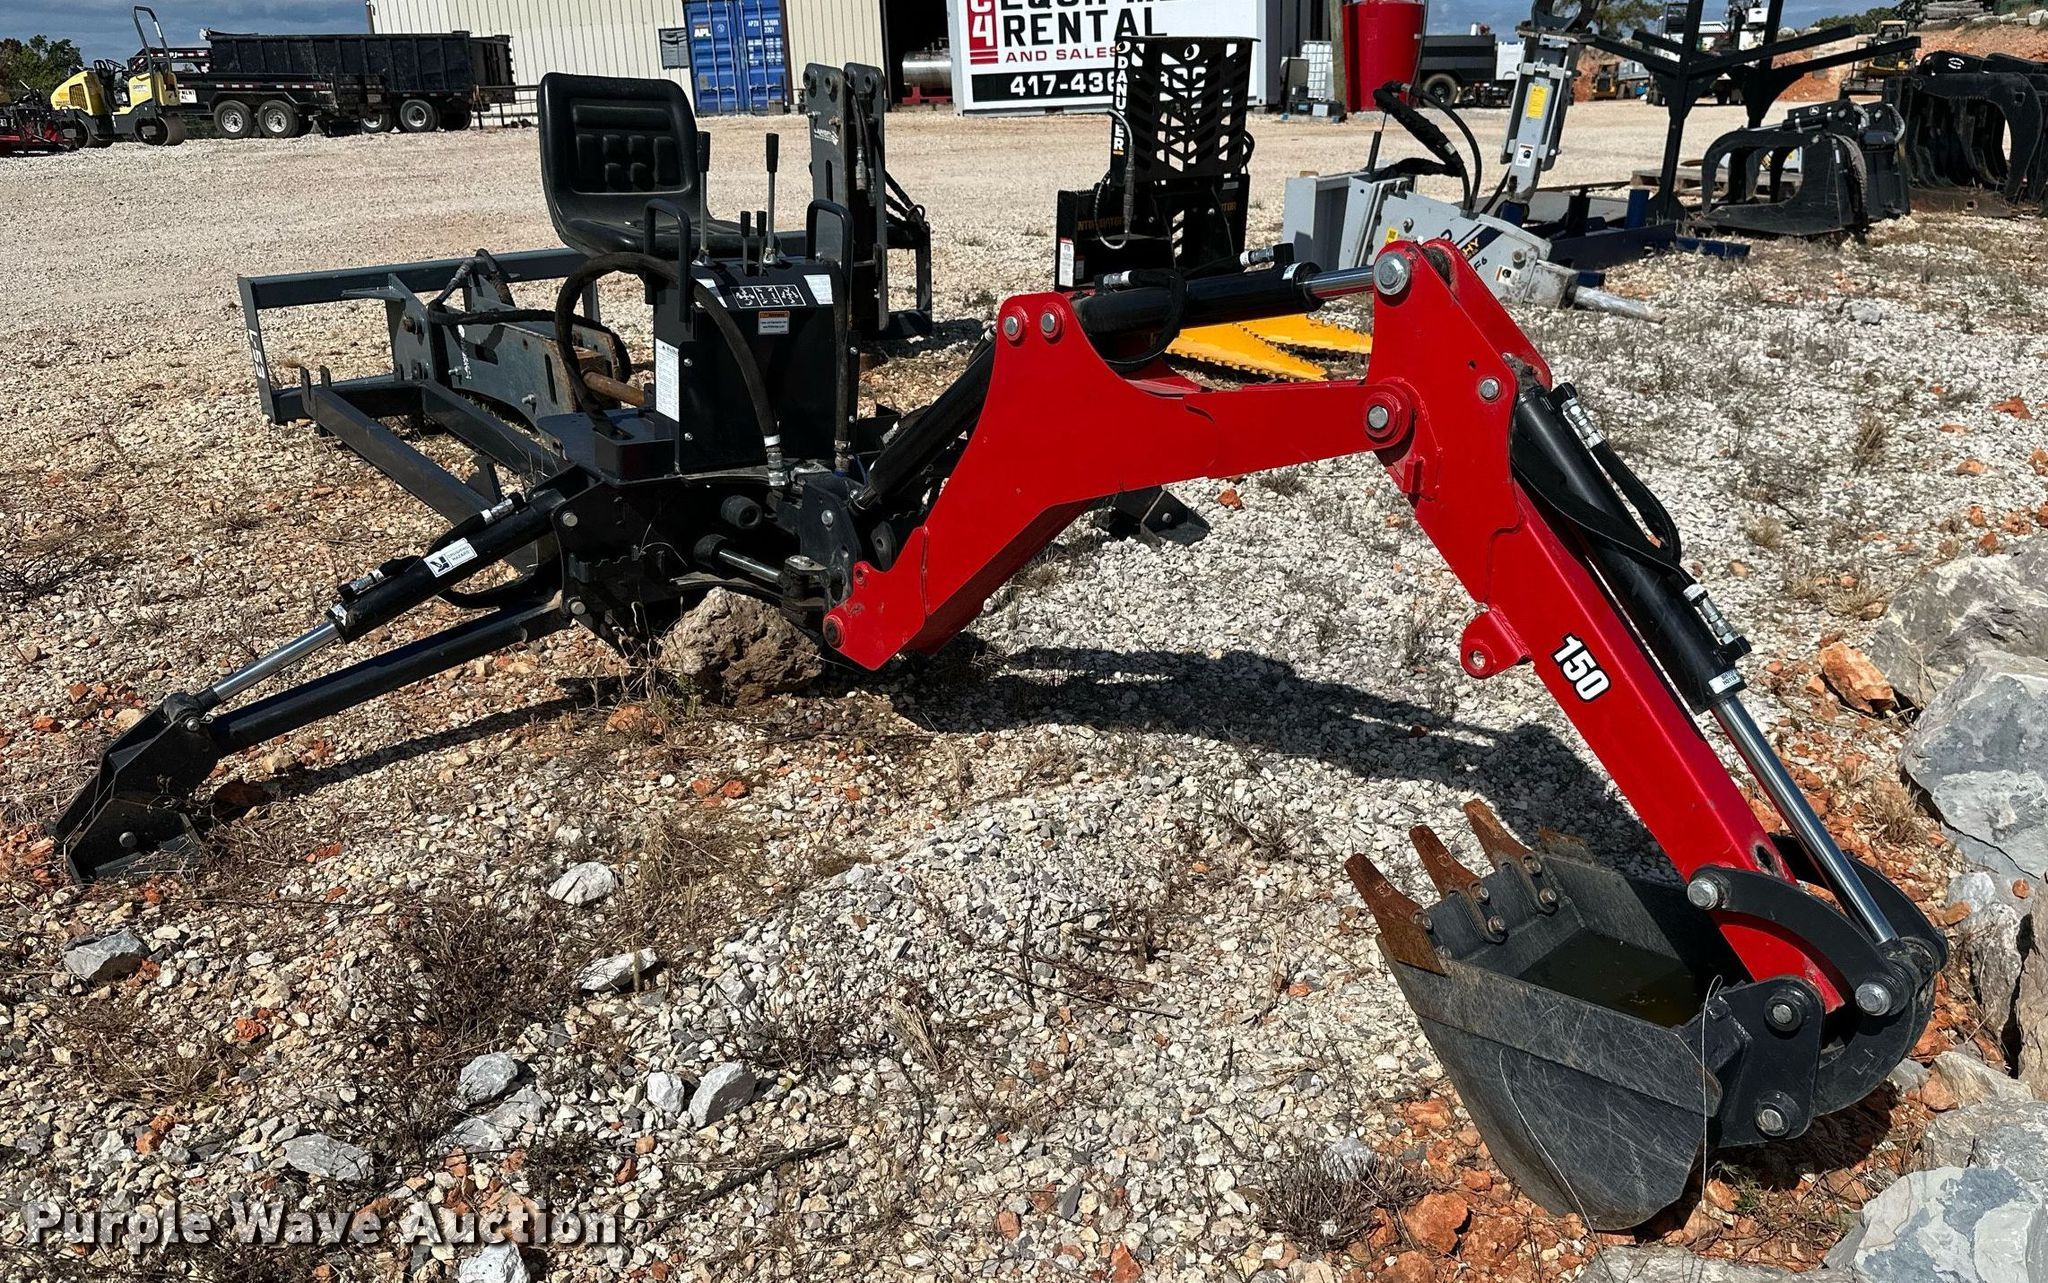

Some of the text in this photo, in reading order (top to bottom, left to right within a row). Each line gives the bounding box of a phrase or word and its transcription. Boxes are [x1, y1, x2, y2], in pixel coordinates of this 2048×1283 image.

[694, 28, 711, 37] APL
[1003, 7, 1168, 47] RENTAL
[1006, 46, 1117, 63] AND SALES
[1113, 55, 1130, 151] DANUER
[1553, 634, 1611, 702] 150
